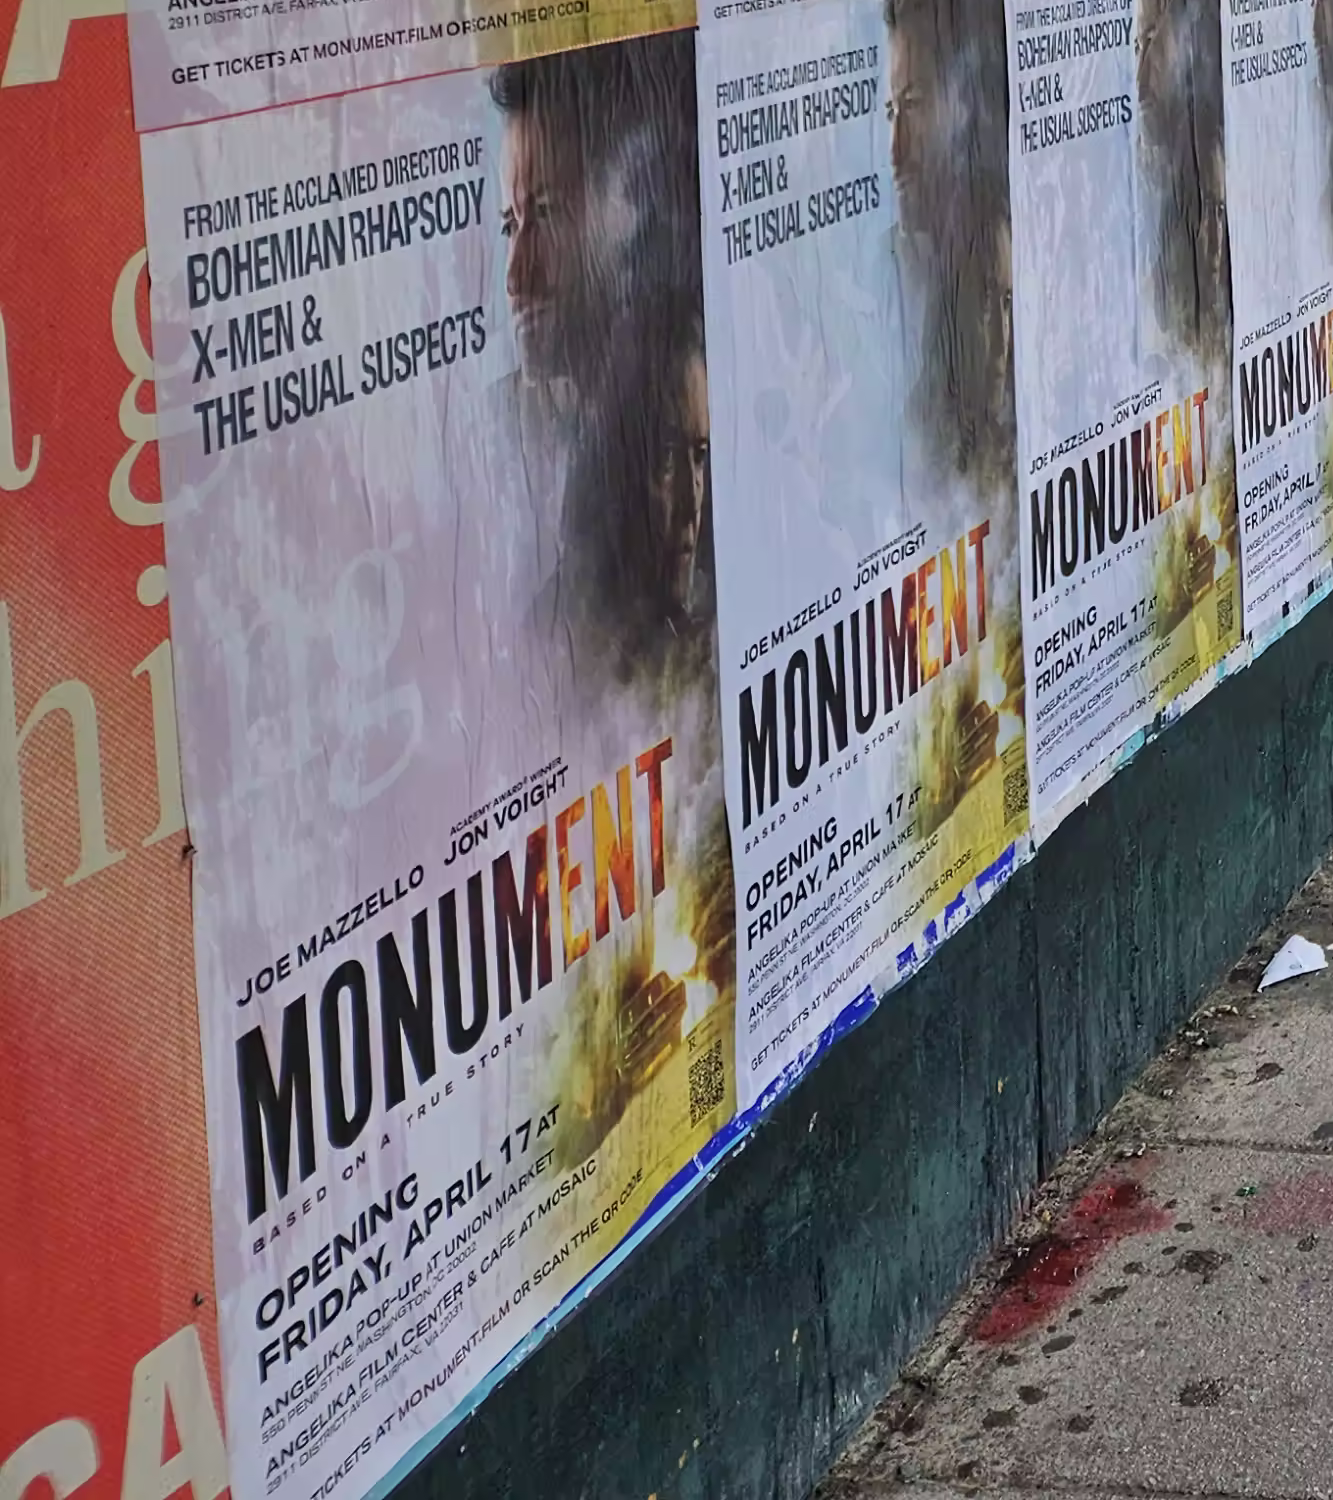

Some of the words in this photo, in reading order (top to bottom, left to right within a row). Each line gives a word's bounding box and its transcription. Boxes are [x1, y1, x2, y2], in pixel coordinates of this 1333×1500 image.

[717, 97, 798, 160] BOHEMIAN
[803, 75, 880, 135] RHAPSODY
[720, 156, 773, 213] X-MEN
[184, 190, 242, 238] FROM
[247, 182, 279, 223] THE
[385, 142, 459, 190] DIRECTOR
[462, 137, 482, 171] OF
[187, 212, 345, 311] BOHEMIAN
[350, 177, 485, 265] RHAPSODY
[722, 216, 751, 266] THE
[754, 198, 805, 254] USUAL
[808, 172, 880, 235] SUSPECTS
[191, 297, 296, 385] X-MEN
[301, 289, 325, 349] &
[196, 383, 259, 460] THE
[264, 351, 356, 436] USUAL
[359, 308, 485, 401] SUSPECTS
[1030, 387, 1208, 602] MONUMENT
[738, 520, 989, 830] MONUMENT
[1034, 602, 1097, 670] OPENING
[1035, 640, 1084, 699] FRIDAY,
[444, 820, 489, 871] JON
[494, 767, 570, 838] VOIGHT
[747, 813, 837, 913] OPENING
[747, 861, 822, 953] FRIDAY,
[826, 810, 881, 881] APRIL
[885, 791, 903, 829] 17
[234, 739, 672, 1228] MONUMENT
[236, 951, 292, 1013] JOE
[296, 863, 426, 972] MAZZELLO
[252, 1181, 328, 1256] BASED
[341, 1148, 370, 1184] ON
[381, 1129, 393, 1151] A
[405, 1079, 455, 1131] TRUE
[467, 1020, 528, 1081] STORY
[255, 1165, 420, 1336] OPENING
[257, 1236, 392, 1388] FRIDAY,
[399, 1147, 494, 1258] APRIL
[498, 1113, 532, 1170] 17
[536, 1100, 560, 1138] AT
